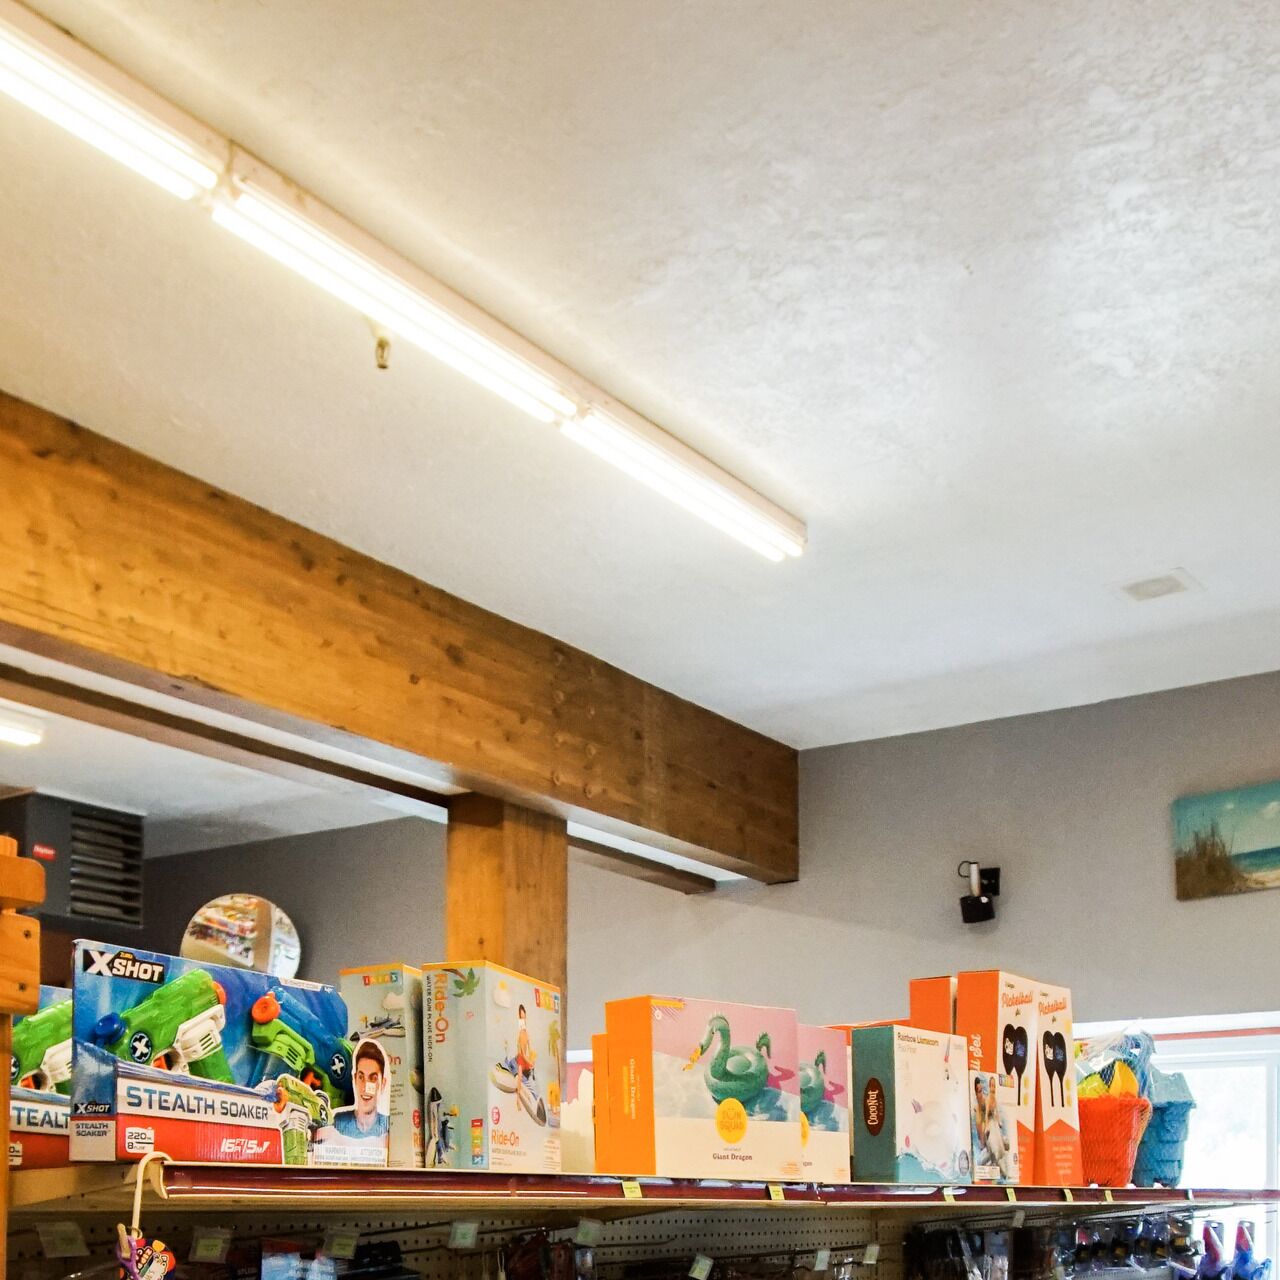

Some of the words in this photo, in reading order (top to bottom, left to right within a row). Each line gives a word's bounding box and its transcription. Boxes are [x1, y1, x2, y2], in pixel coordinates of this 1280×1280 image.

[434, 973, 449, 1043] Ride-On
[126, 1086, 215, 1116] STEALTH
[220, 1103, 269, 1121] SOAKER
[12, 1107, 69, 1129] TEALT
[491, 1129, 520, 1146] Ride-On
[712, 1152, 729, 1161] Giant
[730, 1153, 753, 1162] Dragon
